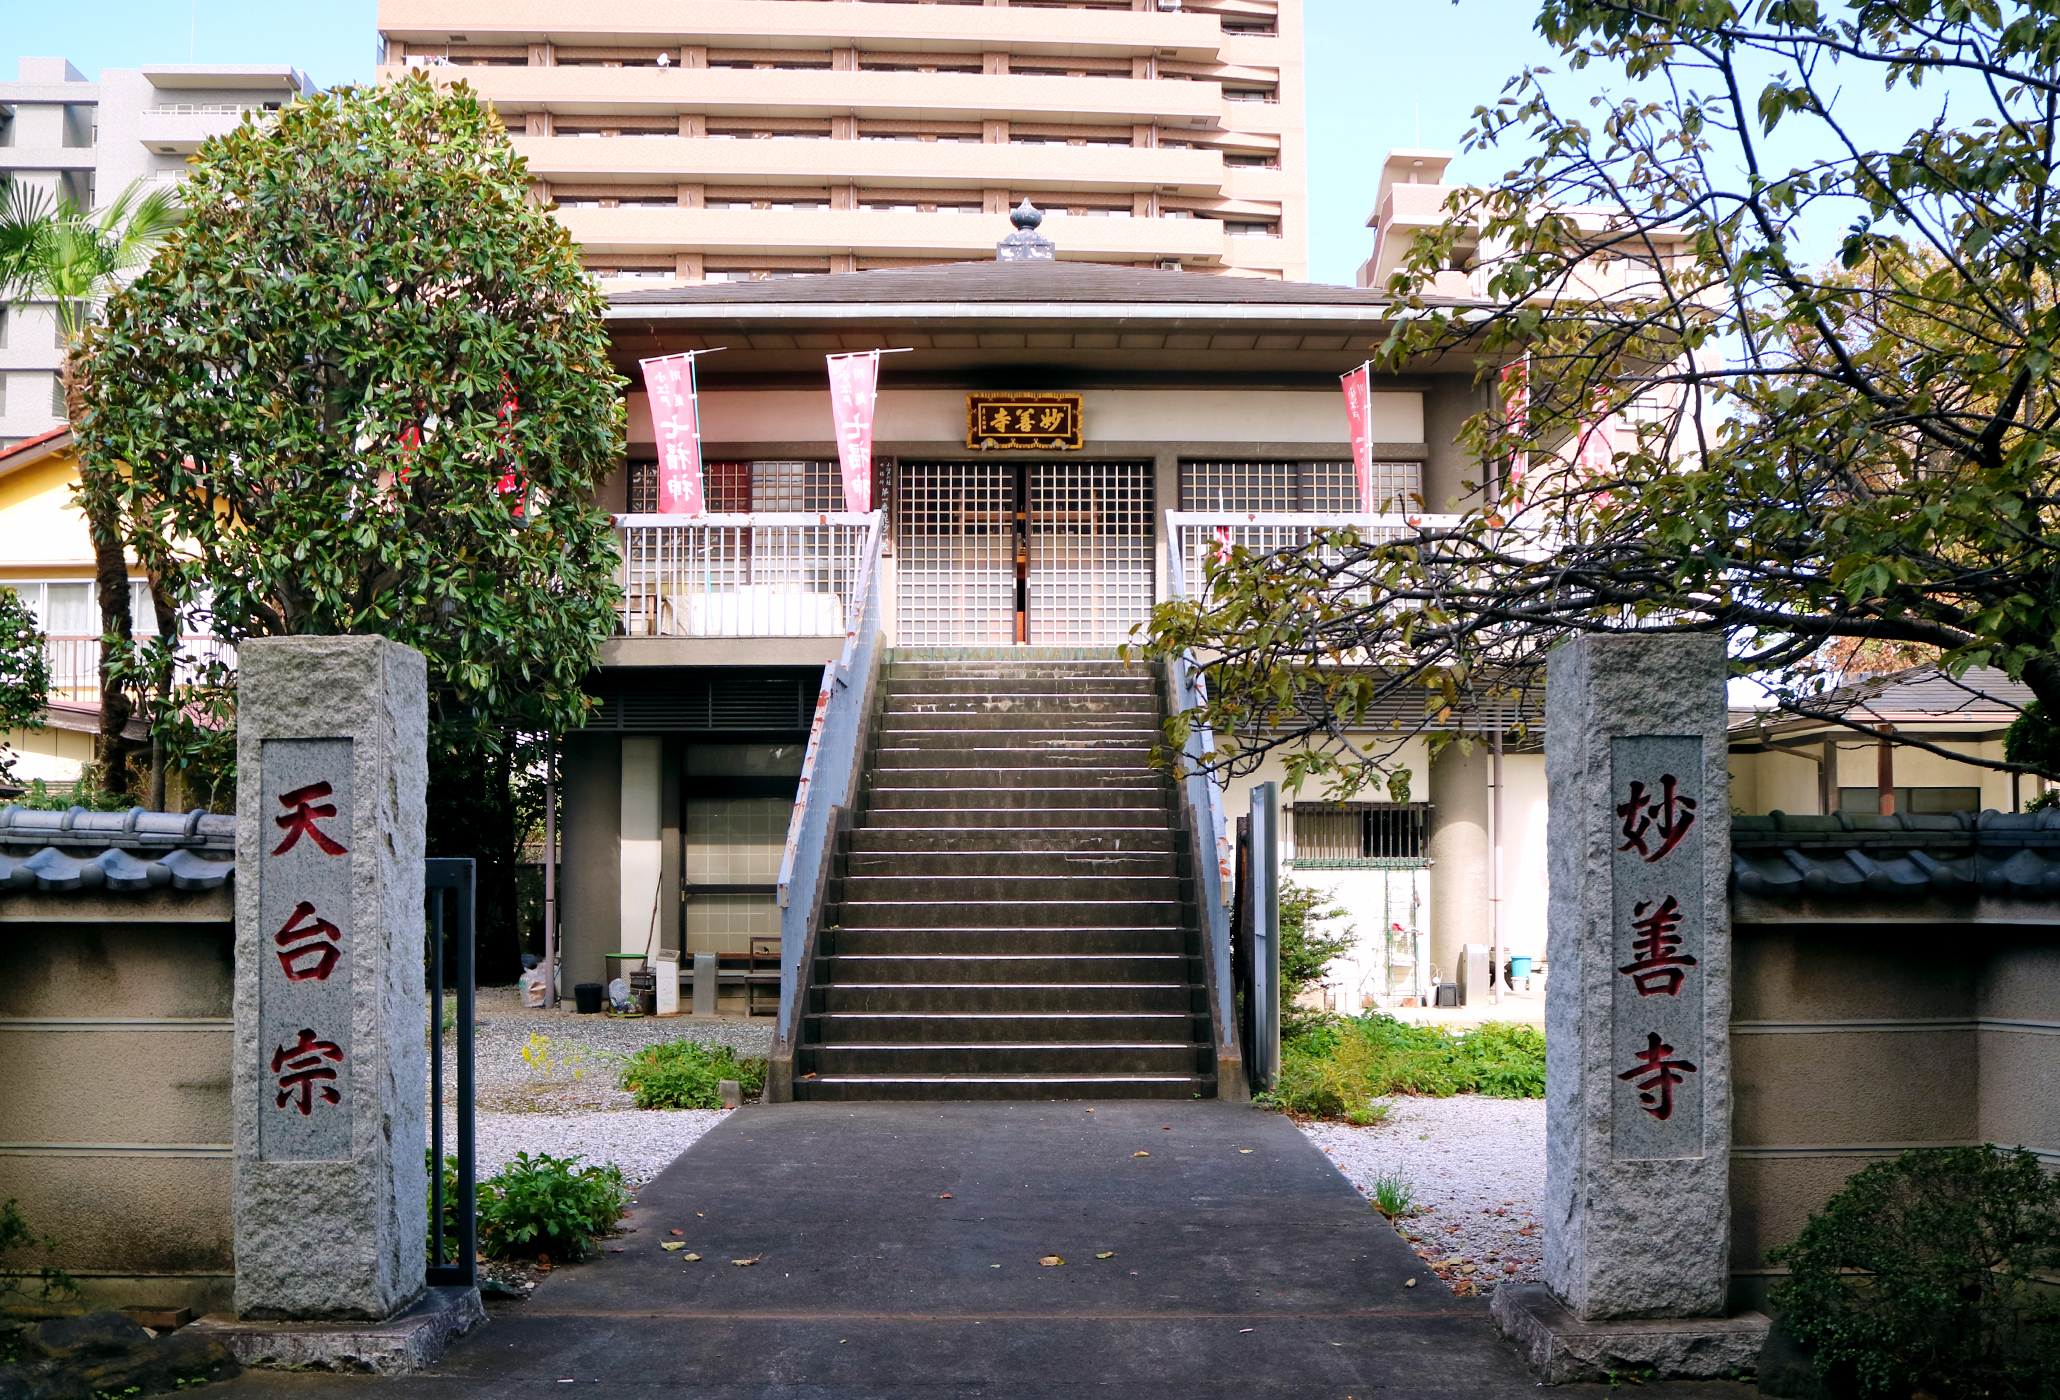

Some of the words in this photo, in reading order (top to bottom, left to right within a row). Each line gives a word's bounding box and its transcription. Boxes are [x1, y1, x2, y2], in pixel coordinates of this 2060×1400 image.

[989, 407, 1065, 433] 妙善寺
[271, 780, 348, 1117] 天台宗
[1616, 773, 1697, 1121] 妙善寺
